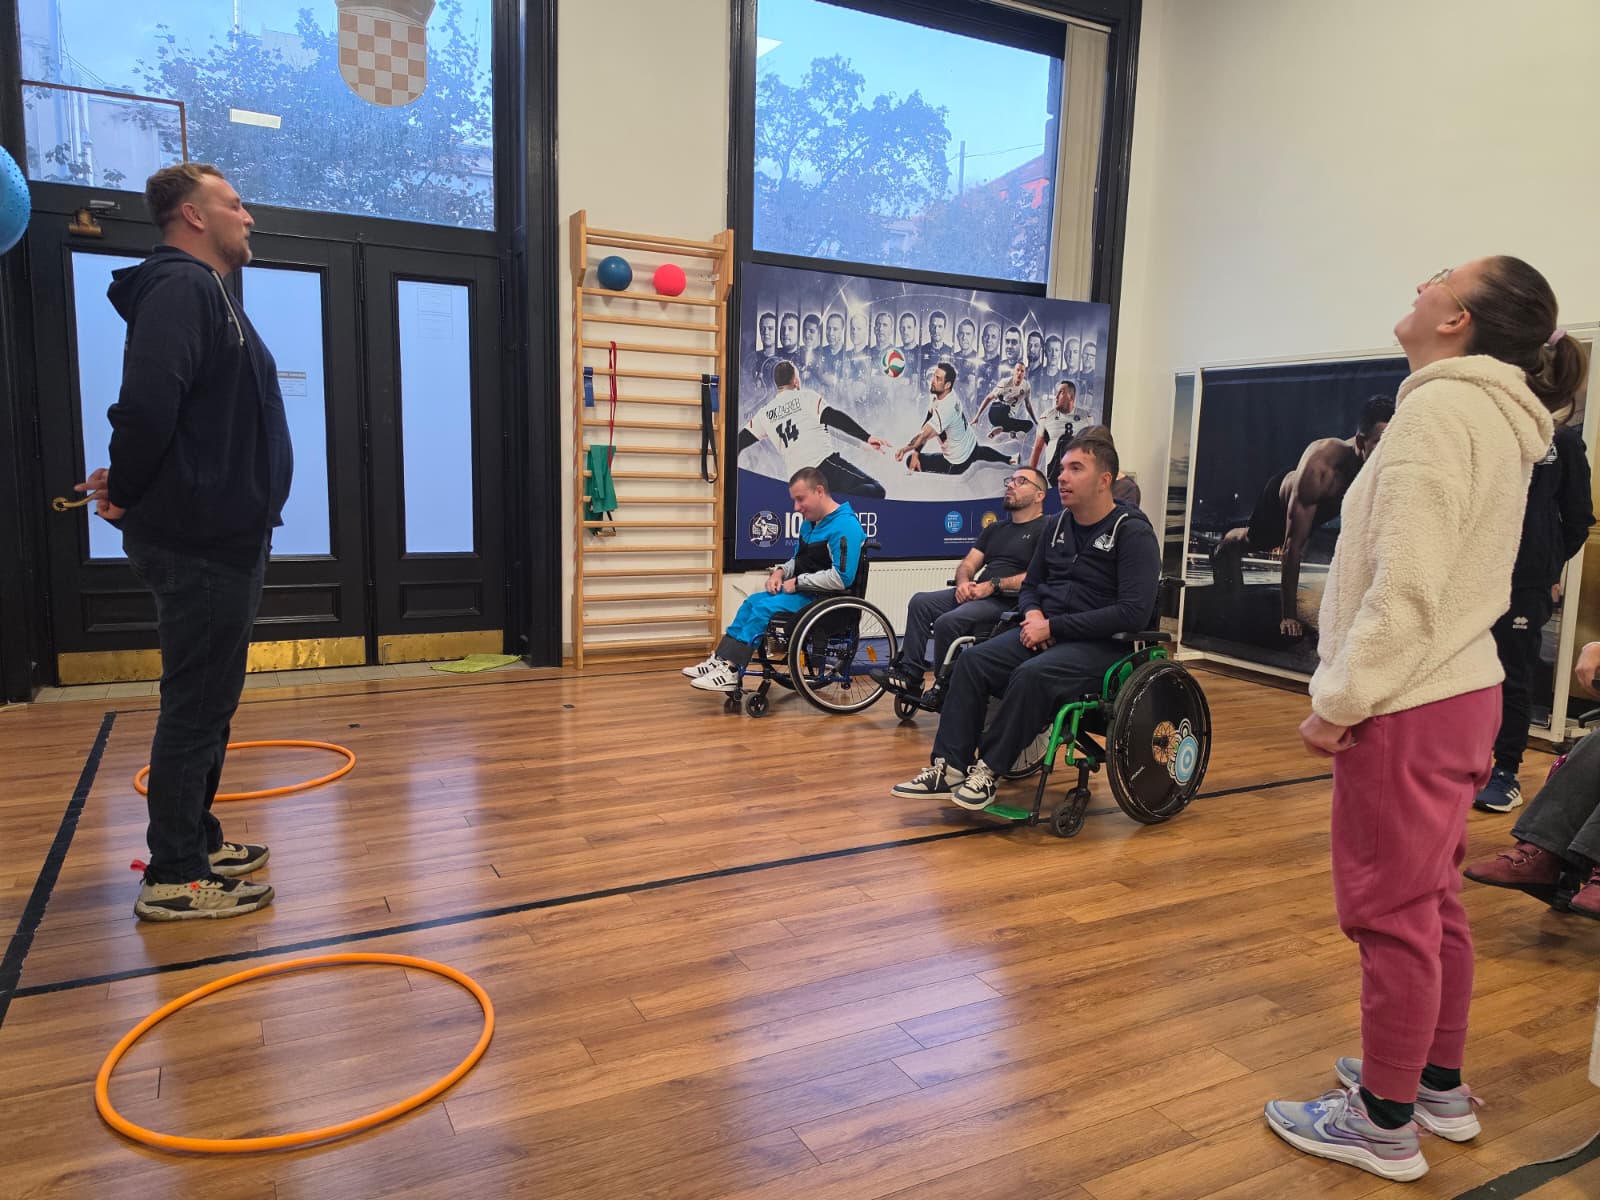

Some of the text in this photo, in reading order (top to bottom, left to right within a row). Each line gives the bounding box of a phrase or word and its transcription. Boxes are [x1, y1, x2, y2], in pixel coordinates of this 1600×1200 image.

[776, 419, 799, 448] 14
[1064, 422, 1074, 435] 8
[785, 511, 804, 538] IO
